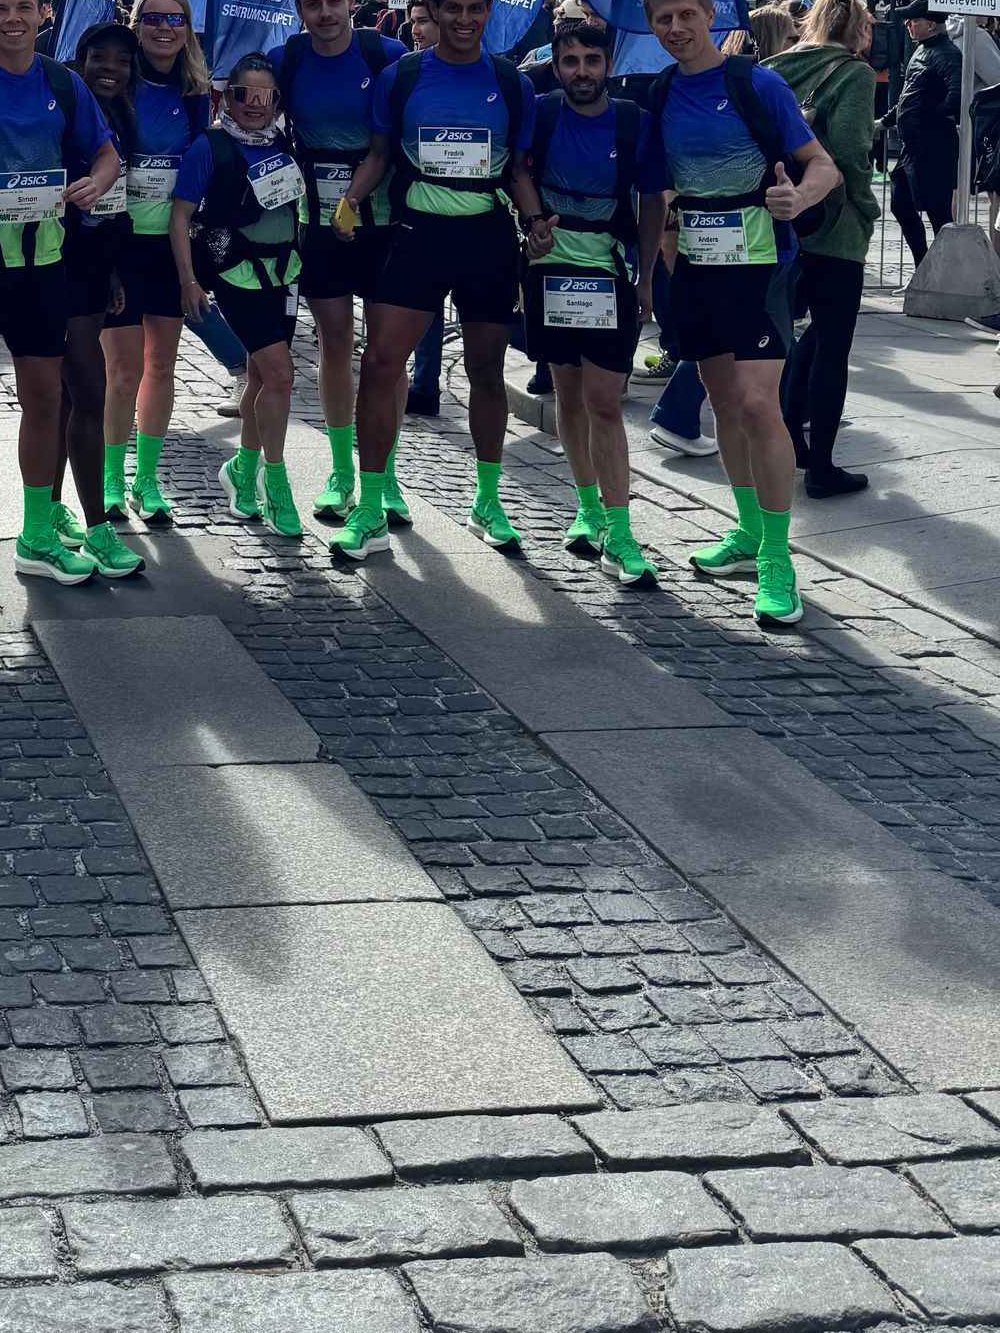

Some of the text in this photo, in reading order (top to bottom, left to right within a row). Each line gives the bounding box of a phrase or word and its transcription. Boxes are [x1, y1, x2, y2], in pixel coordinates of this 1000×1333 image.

[443, 149, 465, 157] Fredrik
[337, 170, 352, 179] asi
[469, 167, 484, 176] XXL
[724, 253, 742, 263] XXL
[566, 299, 593, 308] Santiago
[595, 318, 611, 327] XXL
